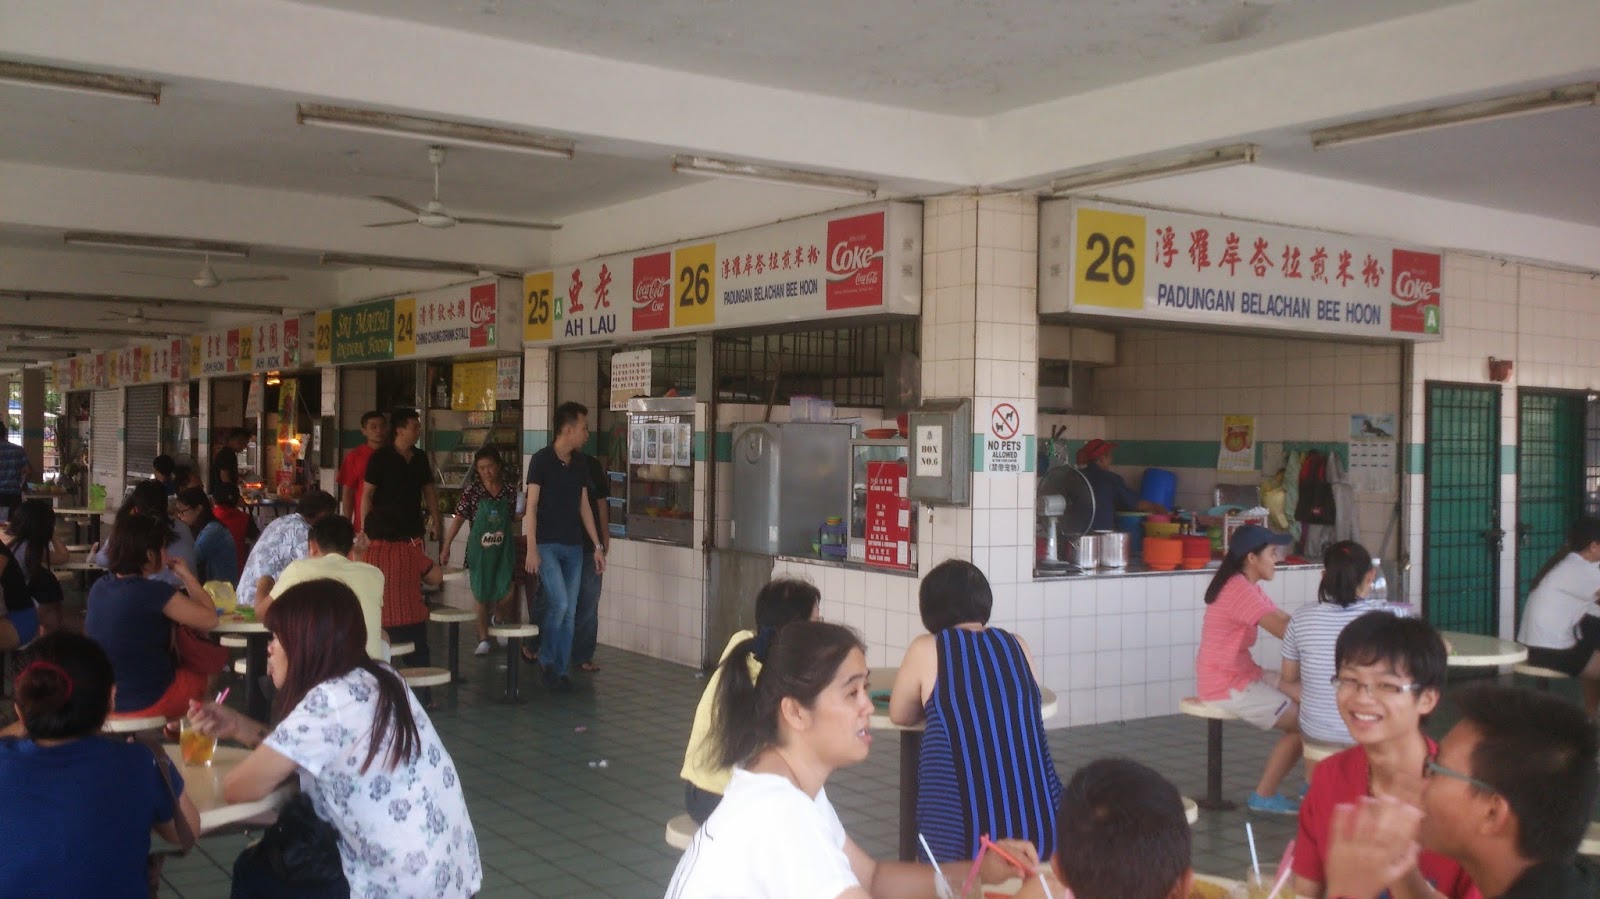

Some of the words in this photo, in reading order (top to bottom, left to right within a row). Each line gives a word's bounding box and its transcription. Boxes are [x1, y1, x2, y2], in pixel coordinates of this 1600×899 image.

[831, 241, 874, 272] Coke
[1085, 232, 1136, 286] 26
[679, 263, 710, 308] 26
[723, 290, 753, 306] PADUNGAN
[754, 285, 785, 302] BELACHAN
[786, 281, 798, 297] BEE
[800, 279, 818, 295] HOON
[1395, 271, 1433, 300] Coke
[472, 301, 492, 322] Coke
[527, 289, 549, 325] 25
[555, 300, 562, 315] A
[1157, 283, 1235, 313] PADUNGAN
[1241, 292, 1311, 319] BELACHAN
[1317, 299, 1341, 322] BEE
[1345, 302, 1382, 325] HOON
[397, 313, 413, 341] 24
[564, 318, 583, 337] AH
[590, 314, 616, 335] LAU
[1427, 310, 1436, 327] A
[317, 324, 330, 349] 23
[455, 327, 469, 340] STALL
[488, 327, 494, 341] A
[241, 337, 251, 360] 22
[921, 445, 938, 454] BOX
[988, 440, 999, 451] NO
[1001, 440, 1021, 451] PETS
[992, 451, 1018, 459] ALLOWED
[921, 457, 939, 466] NO.6
[483, 535, 502, 544] MILO
